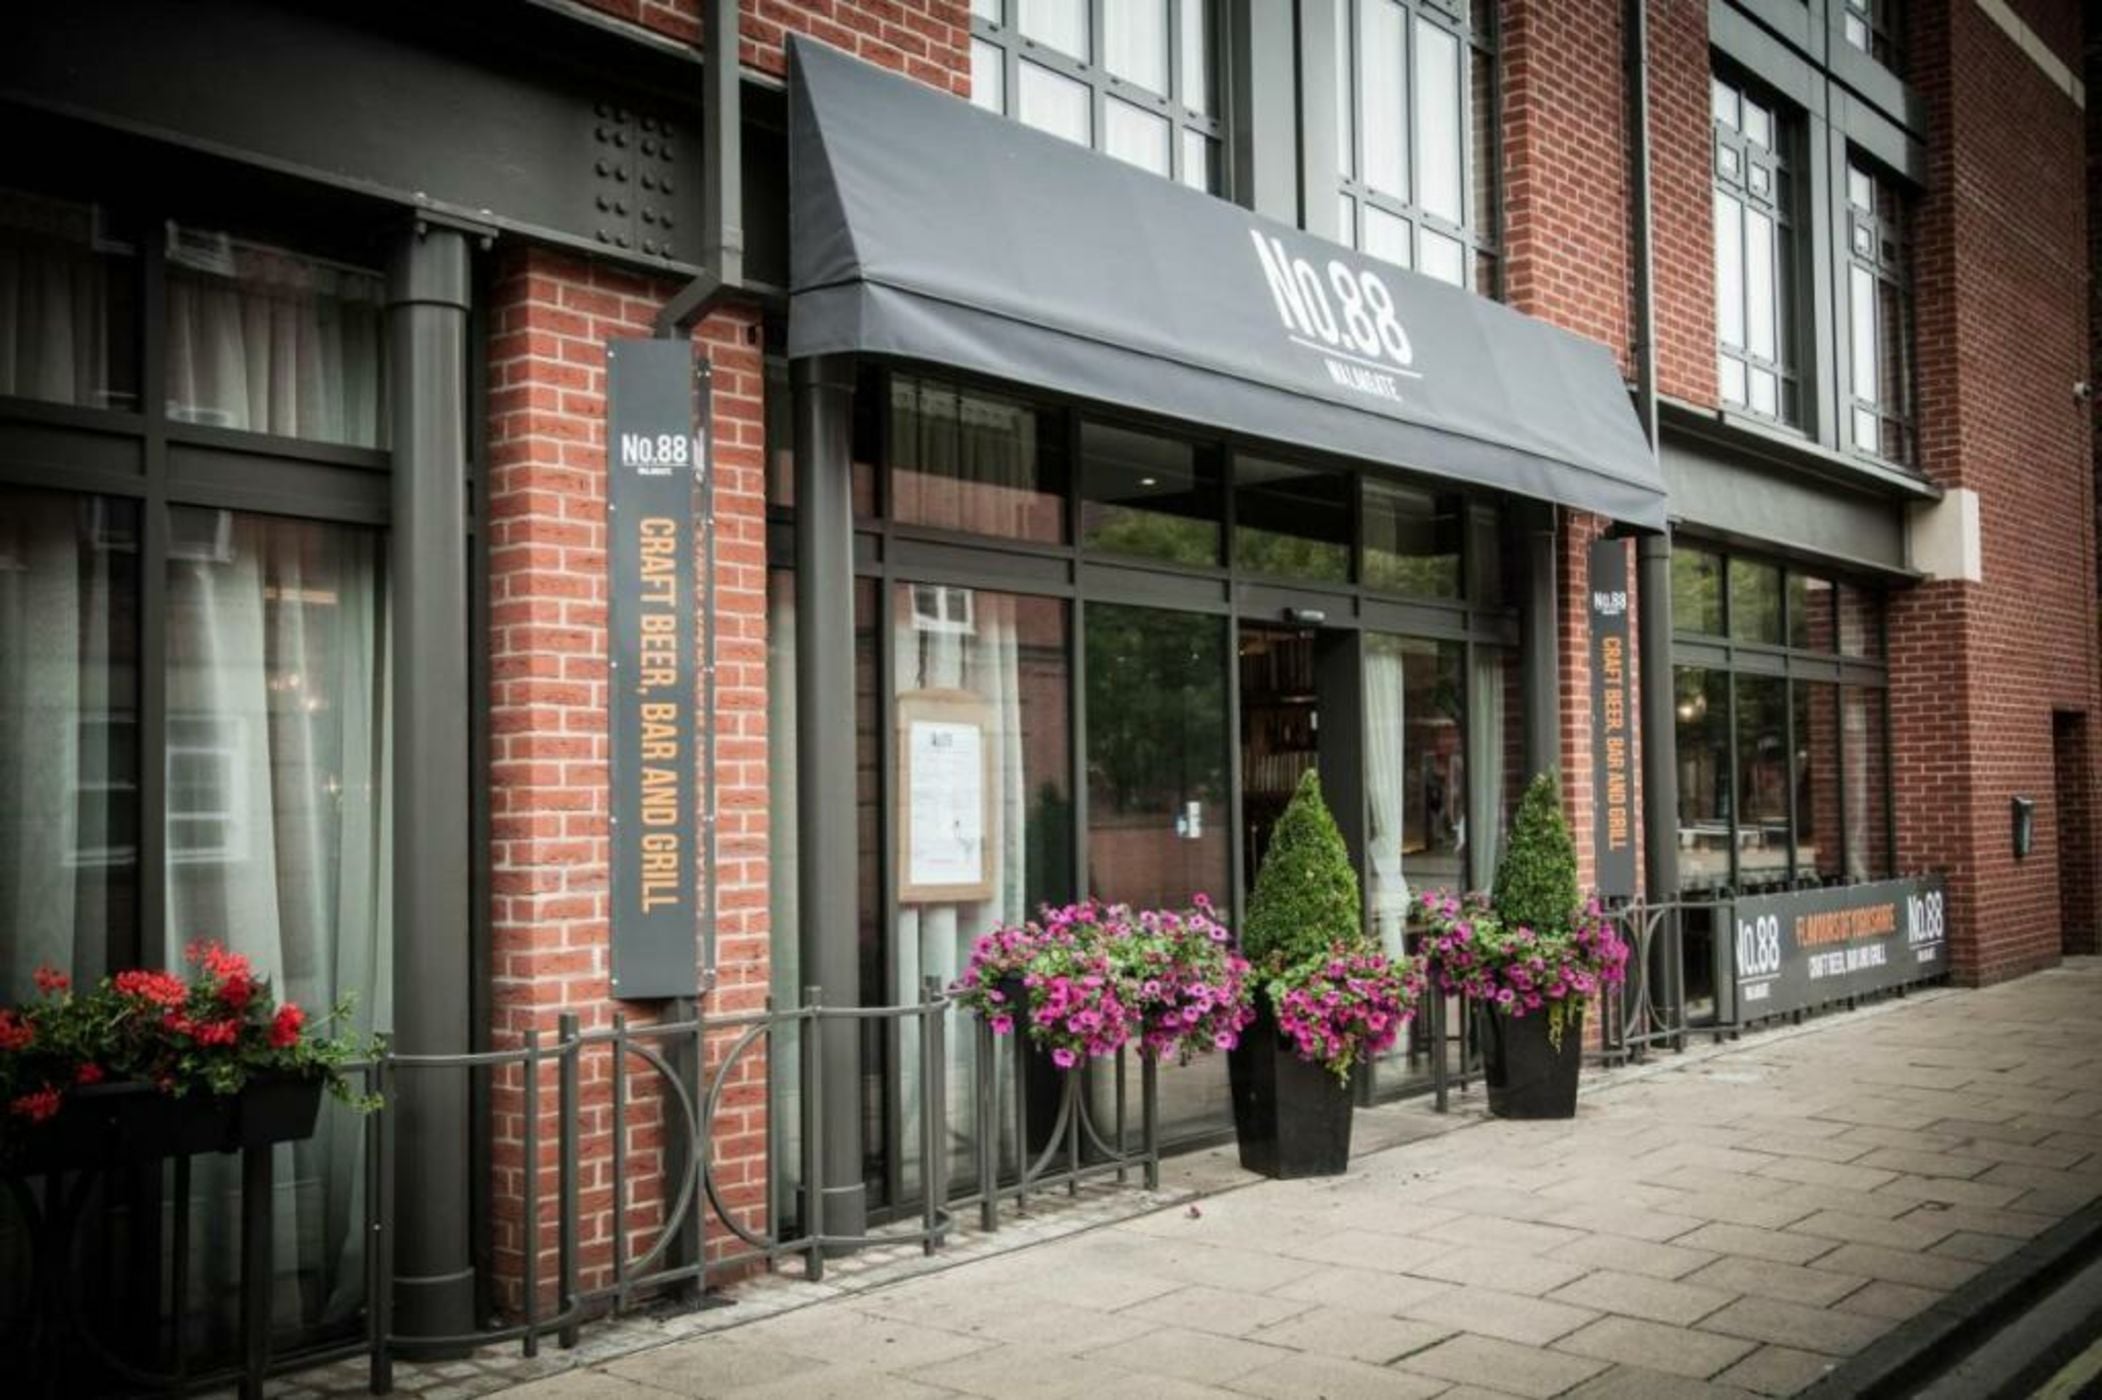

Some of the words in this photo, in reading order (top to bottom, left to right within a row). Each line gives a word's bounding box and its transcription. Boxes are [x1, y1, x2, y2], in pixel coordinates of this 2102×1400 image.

[1250, 228, 1413, 365] No.88
[621, 432, 688, 464] No.88
[639, 517, 677, 607] CRAFT
[1594, 591, 1627, 610] No.88
[635, 613, 677, 695] BEER,
[1603, 637, 1623, 685] CRAFT
[640, 703, 678, 759] BAR
[1607, 737, 1625, 770] BAR
[641, 768, 678, 826] AND
[1607, 771, 1627, 804] AND
[1609, 807, 1628, 850] GRILL
[641, 833, 679, 913] GRILL
[1907, 891, 1944, 943] No.88
